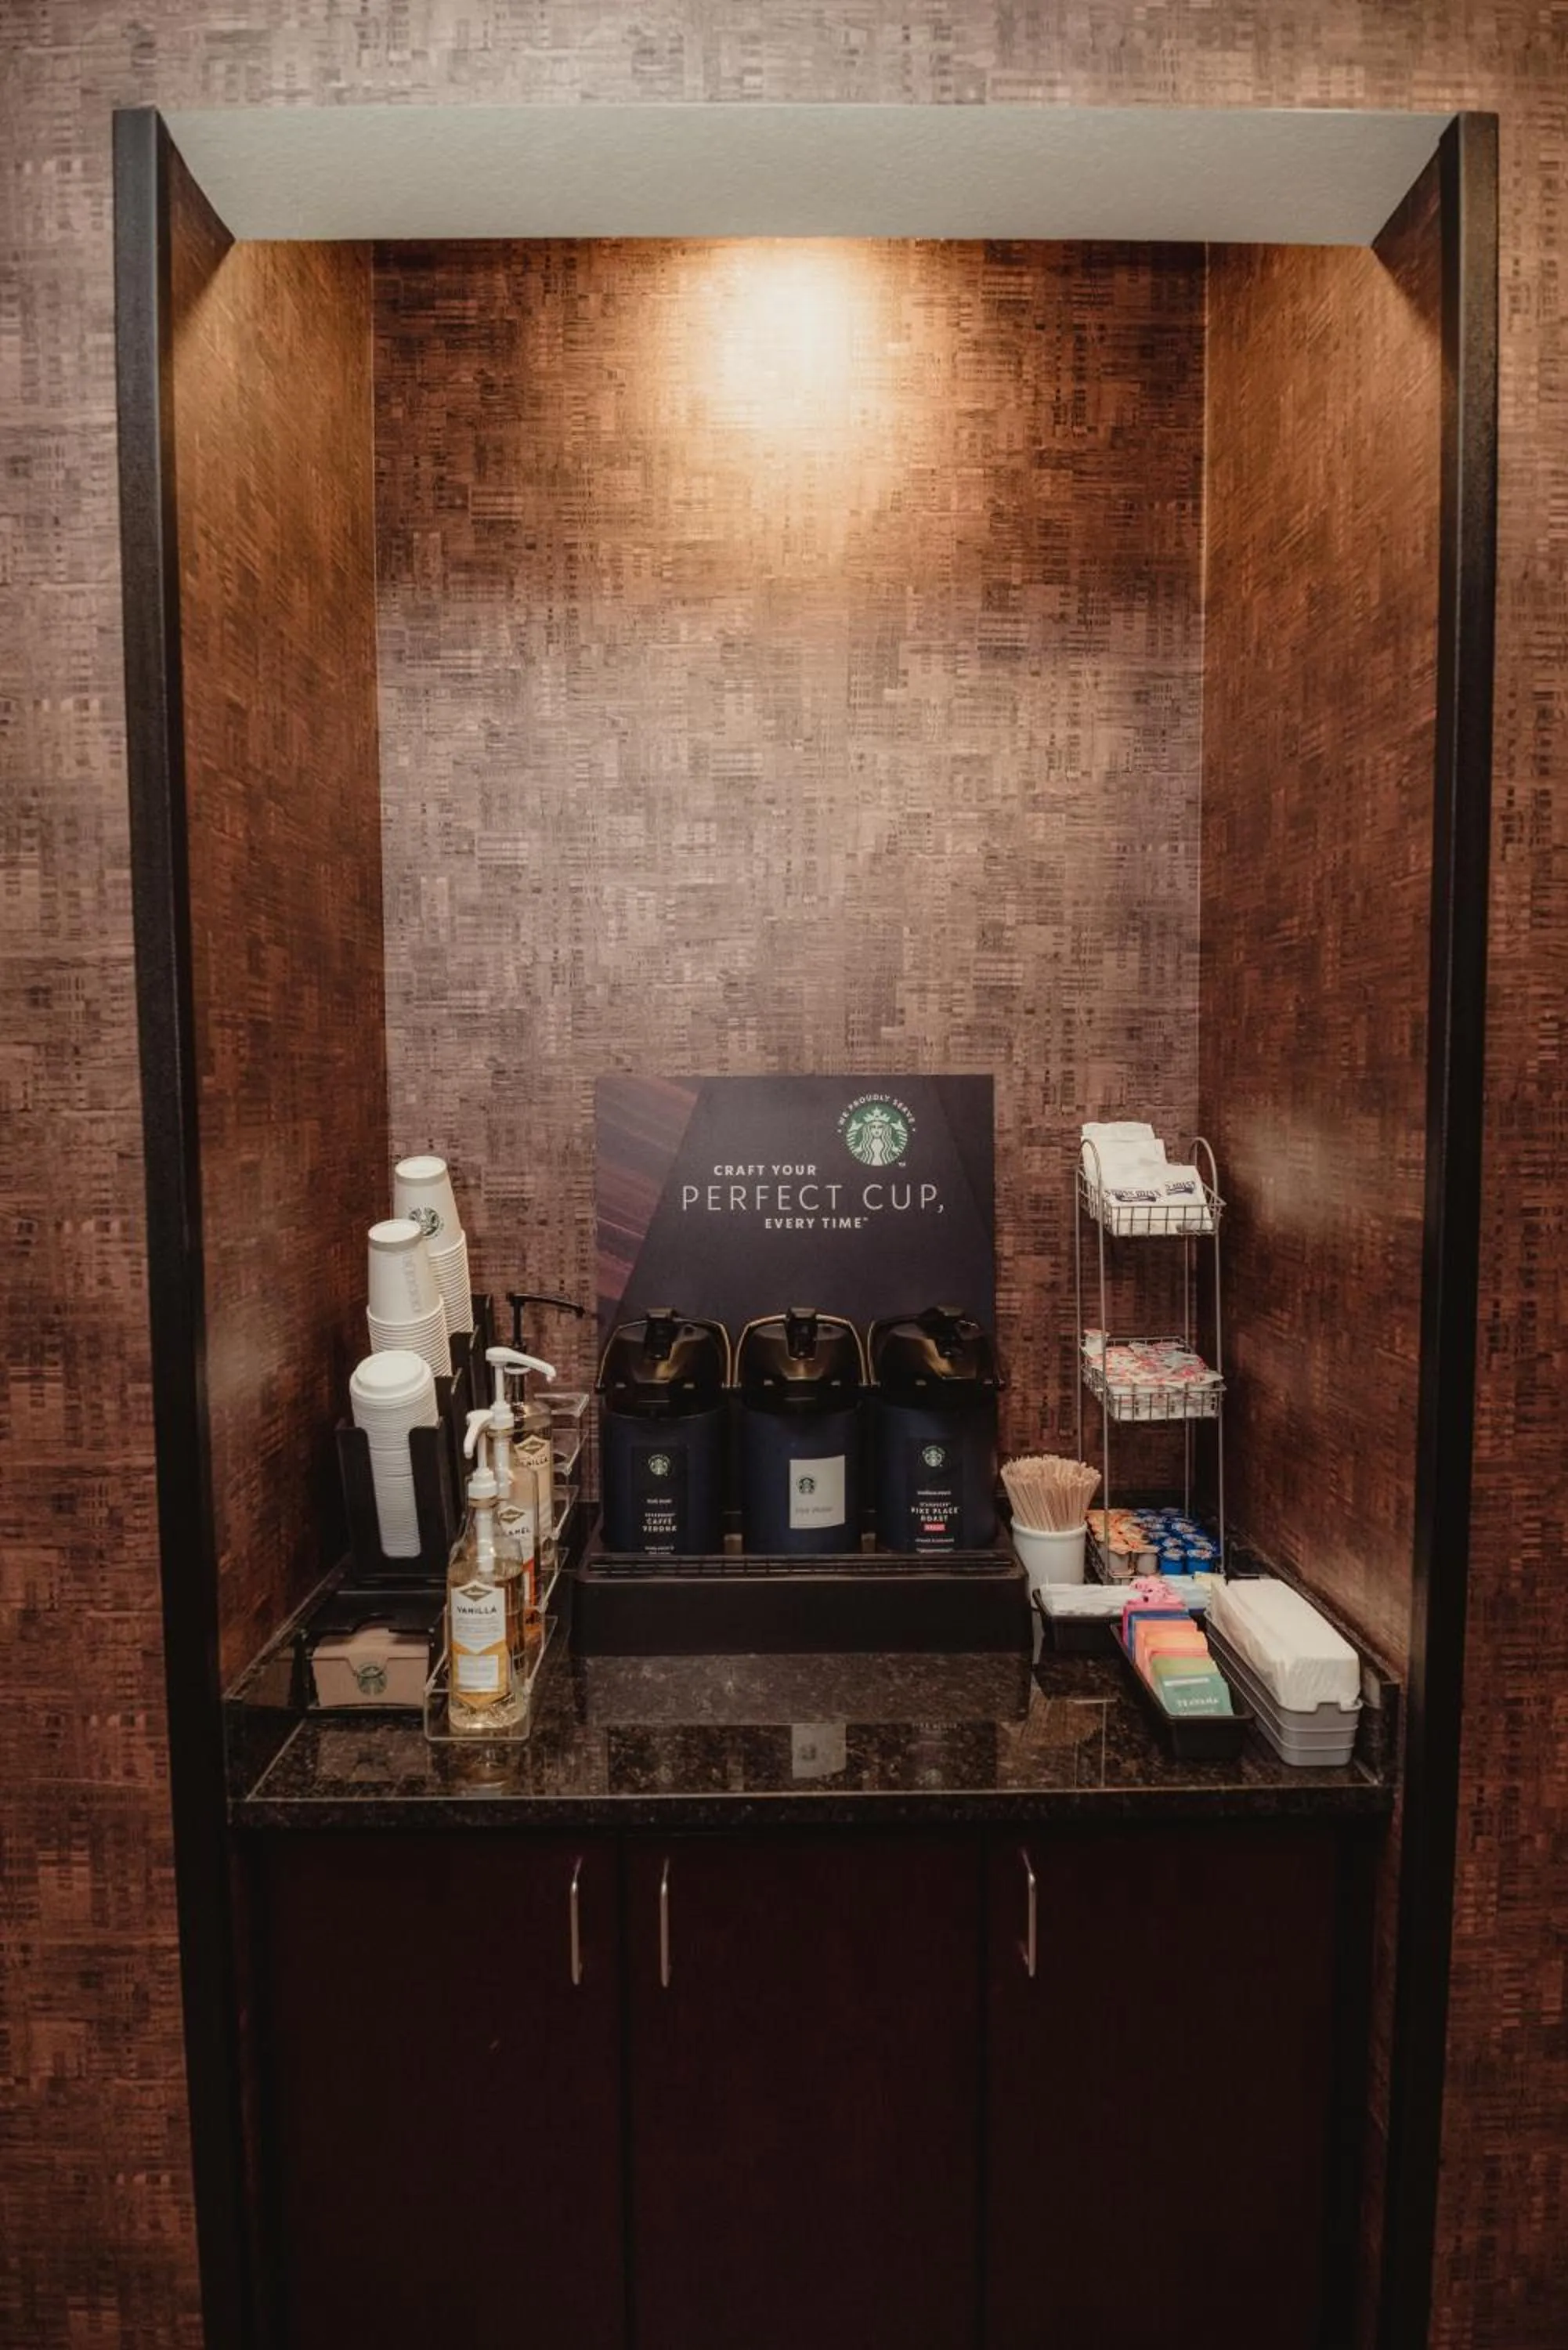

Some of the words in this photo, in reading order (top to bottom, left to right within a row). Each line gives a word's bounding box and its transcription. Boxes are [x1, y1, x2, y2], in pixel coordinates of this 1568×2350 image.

[714, 1164, 765, 1176] CRAFT
[771, 1164, 816, 1176] YOUR
[682, 1184, 843, 1211] PERFECT
[863, 1183, 945, 1213] CUP,
[764, 1217, 815, 1229] EVERY
[457, 1606, 497, 1614] VANILLA
